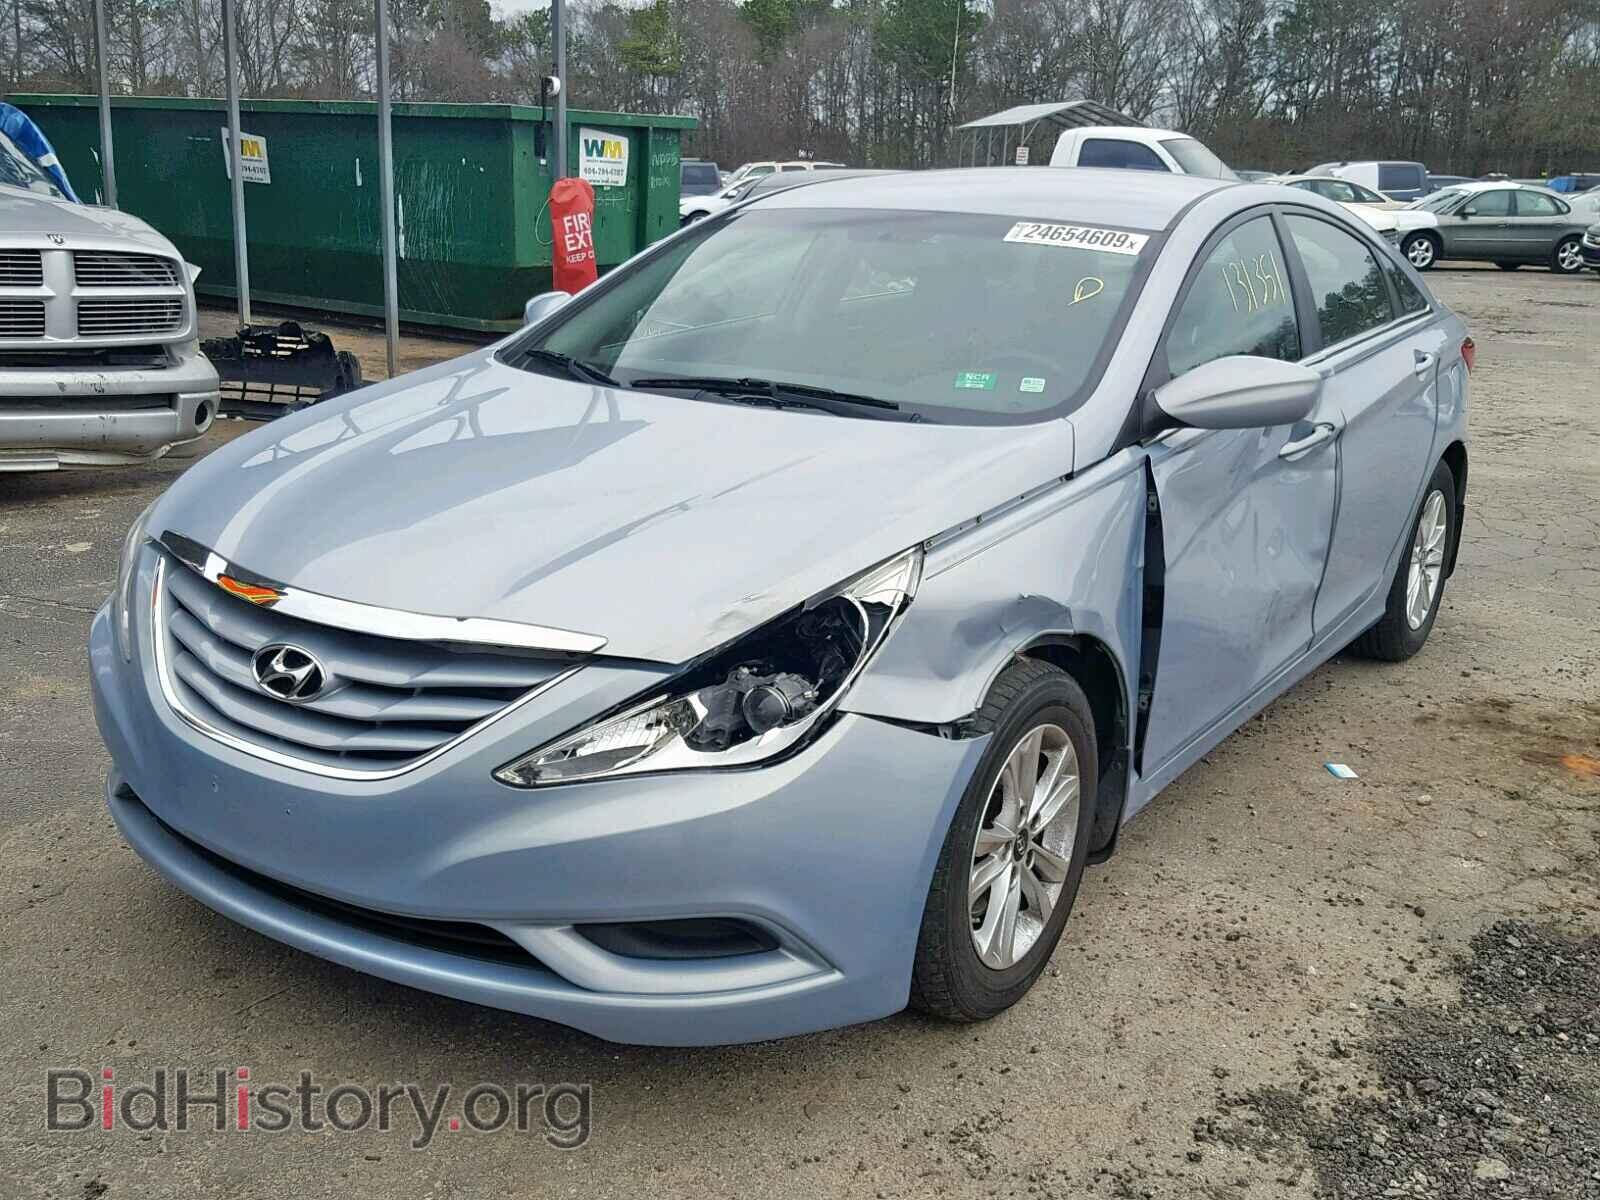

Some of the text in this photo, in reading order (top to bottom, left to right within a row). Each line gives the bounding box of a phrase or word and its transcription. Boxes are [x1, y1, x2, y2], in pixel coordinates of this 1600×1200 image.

[583, 138, 626, 159] WM
[1023, 223, 1131, 249] 24654609
[566, 253, 586, 264] KEEP
